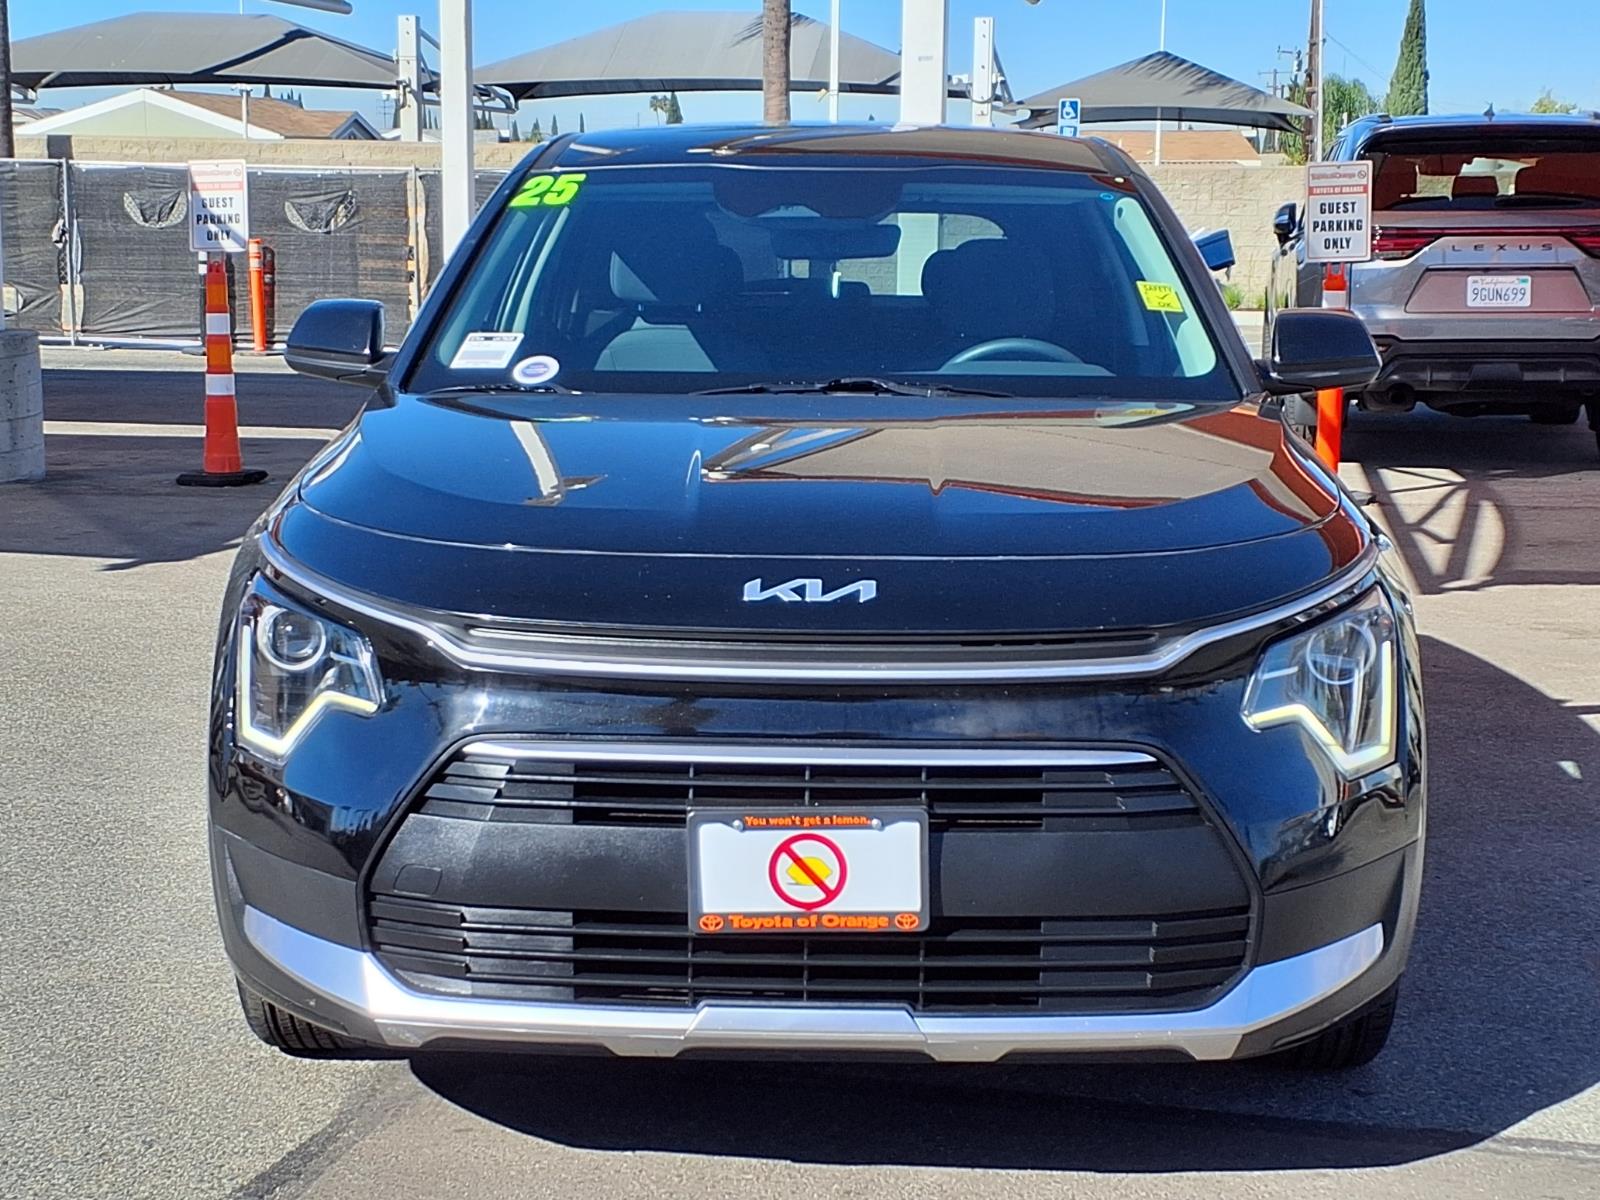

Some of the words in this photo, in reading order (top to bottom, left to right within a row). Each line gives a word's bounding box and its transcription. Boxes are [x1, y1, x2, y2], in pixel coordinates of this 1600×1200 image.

[508, 173, 587, 207] 25
[201, 197, 234, 209] GUEST
[1319, 201, 1357, 214] GUEST
[196, 213, 241, 225] PARKING
[1312, 219, 1363, 232] PARKING
[206, 229, 232, 241] ONLY
[1323, 237, 1352, 250] ONLY
[1451, 243, 1553, 252] LEXUS
[1471, 287, 1527, 302] 9GUN699
[743, 578, 877, 602] KIA
[745, 816, 767, 826] You
[768, 815, 801, 826] won't
[803, 815, 822, 827] get
[823, 817, 831, 825] a
[832, 815, 871, 825] lemon.
[728, 914, 794, 930] Toyota
[796, 914, 818, 929] of
[821, 913, 889, 930] Orange
